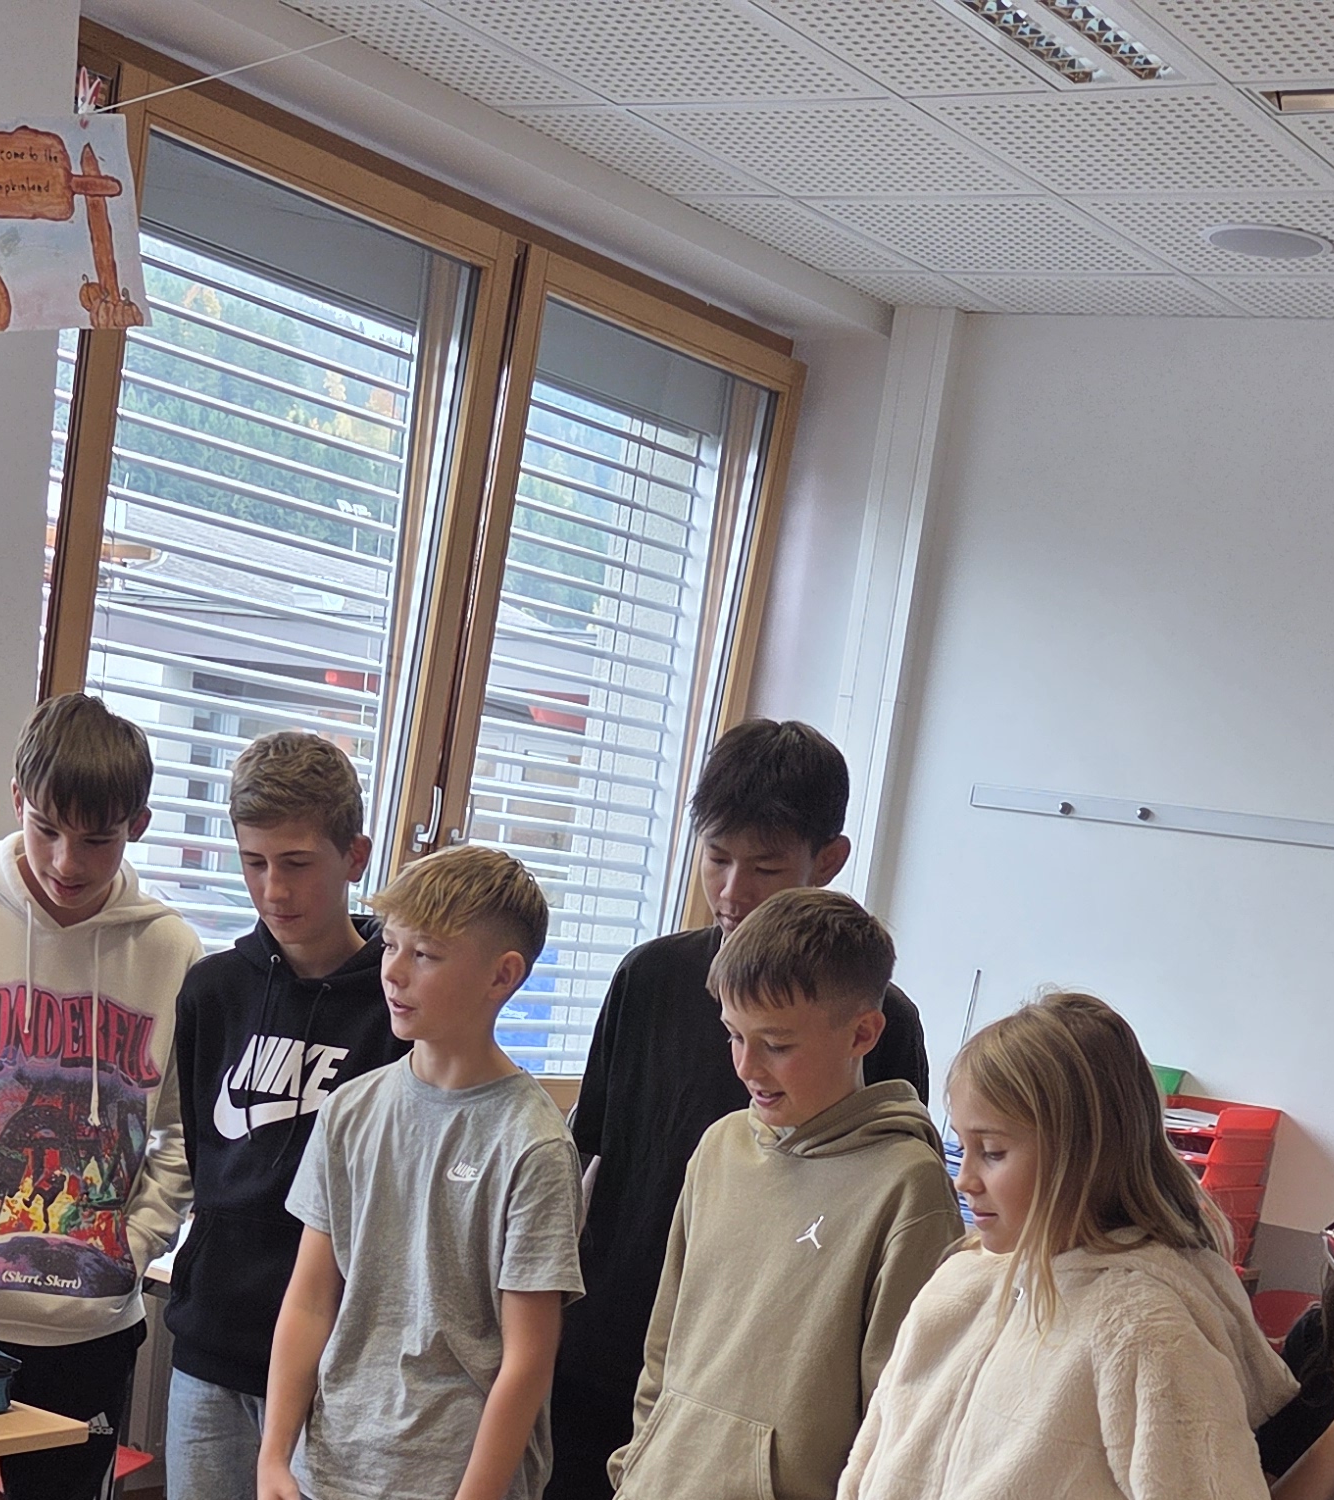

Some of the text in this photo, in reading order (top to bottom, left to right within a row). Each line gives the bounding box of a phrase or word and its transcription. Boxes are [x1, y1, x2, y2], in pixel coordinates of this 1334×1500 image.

[29, 146, 38, 161] to
[45, 148, 58, 163] the
[230, 1034, 350, 1100] NIKE
[454, 1161, 479, 1178] NIKE
[2, 1270, 82, 1290] (Skrrt, Skrrt)
